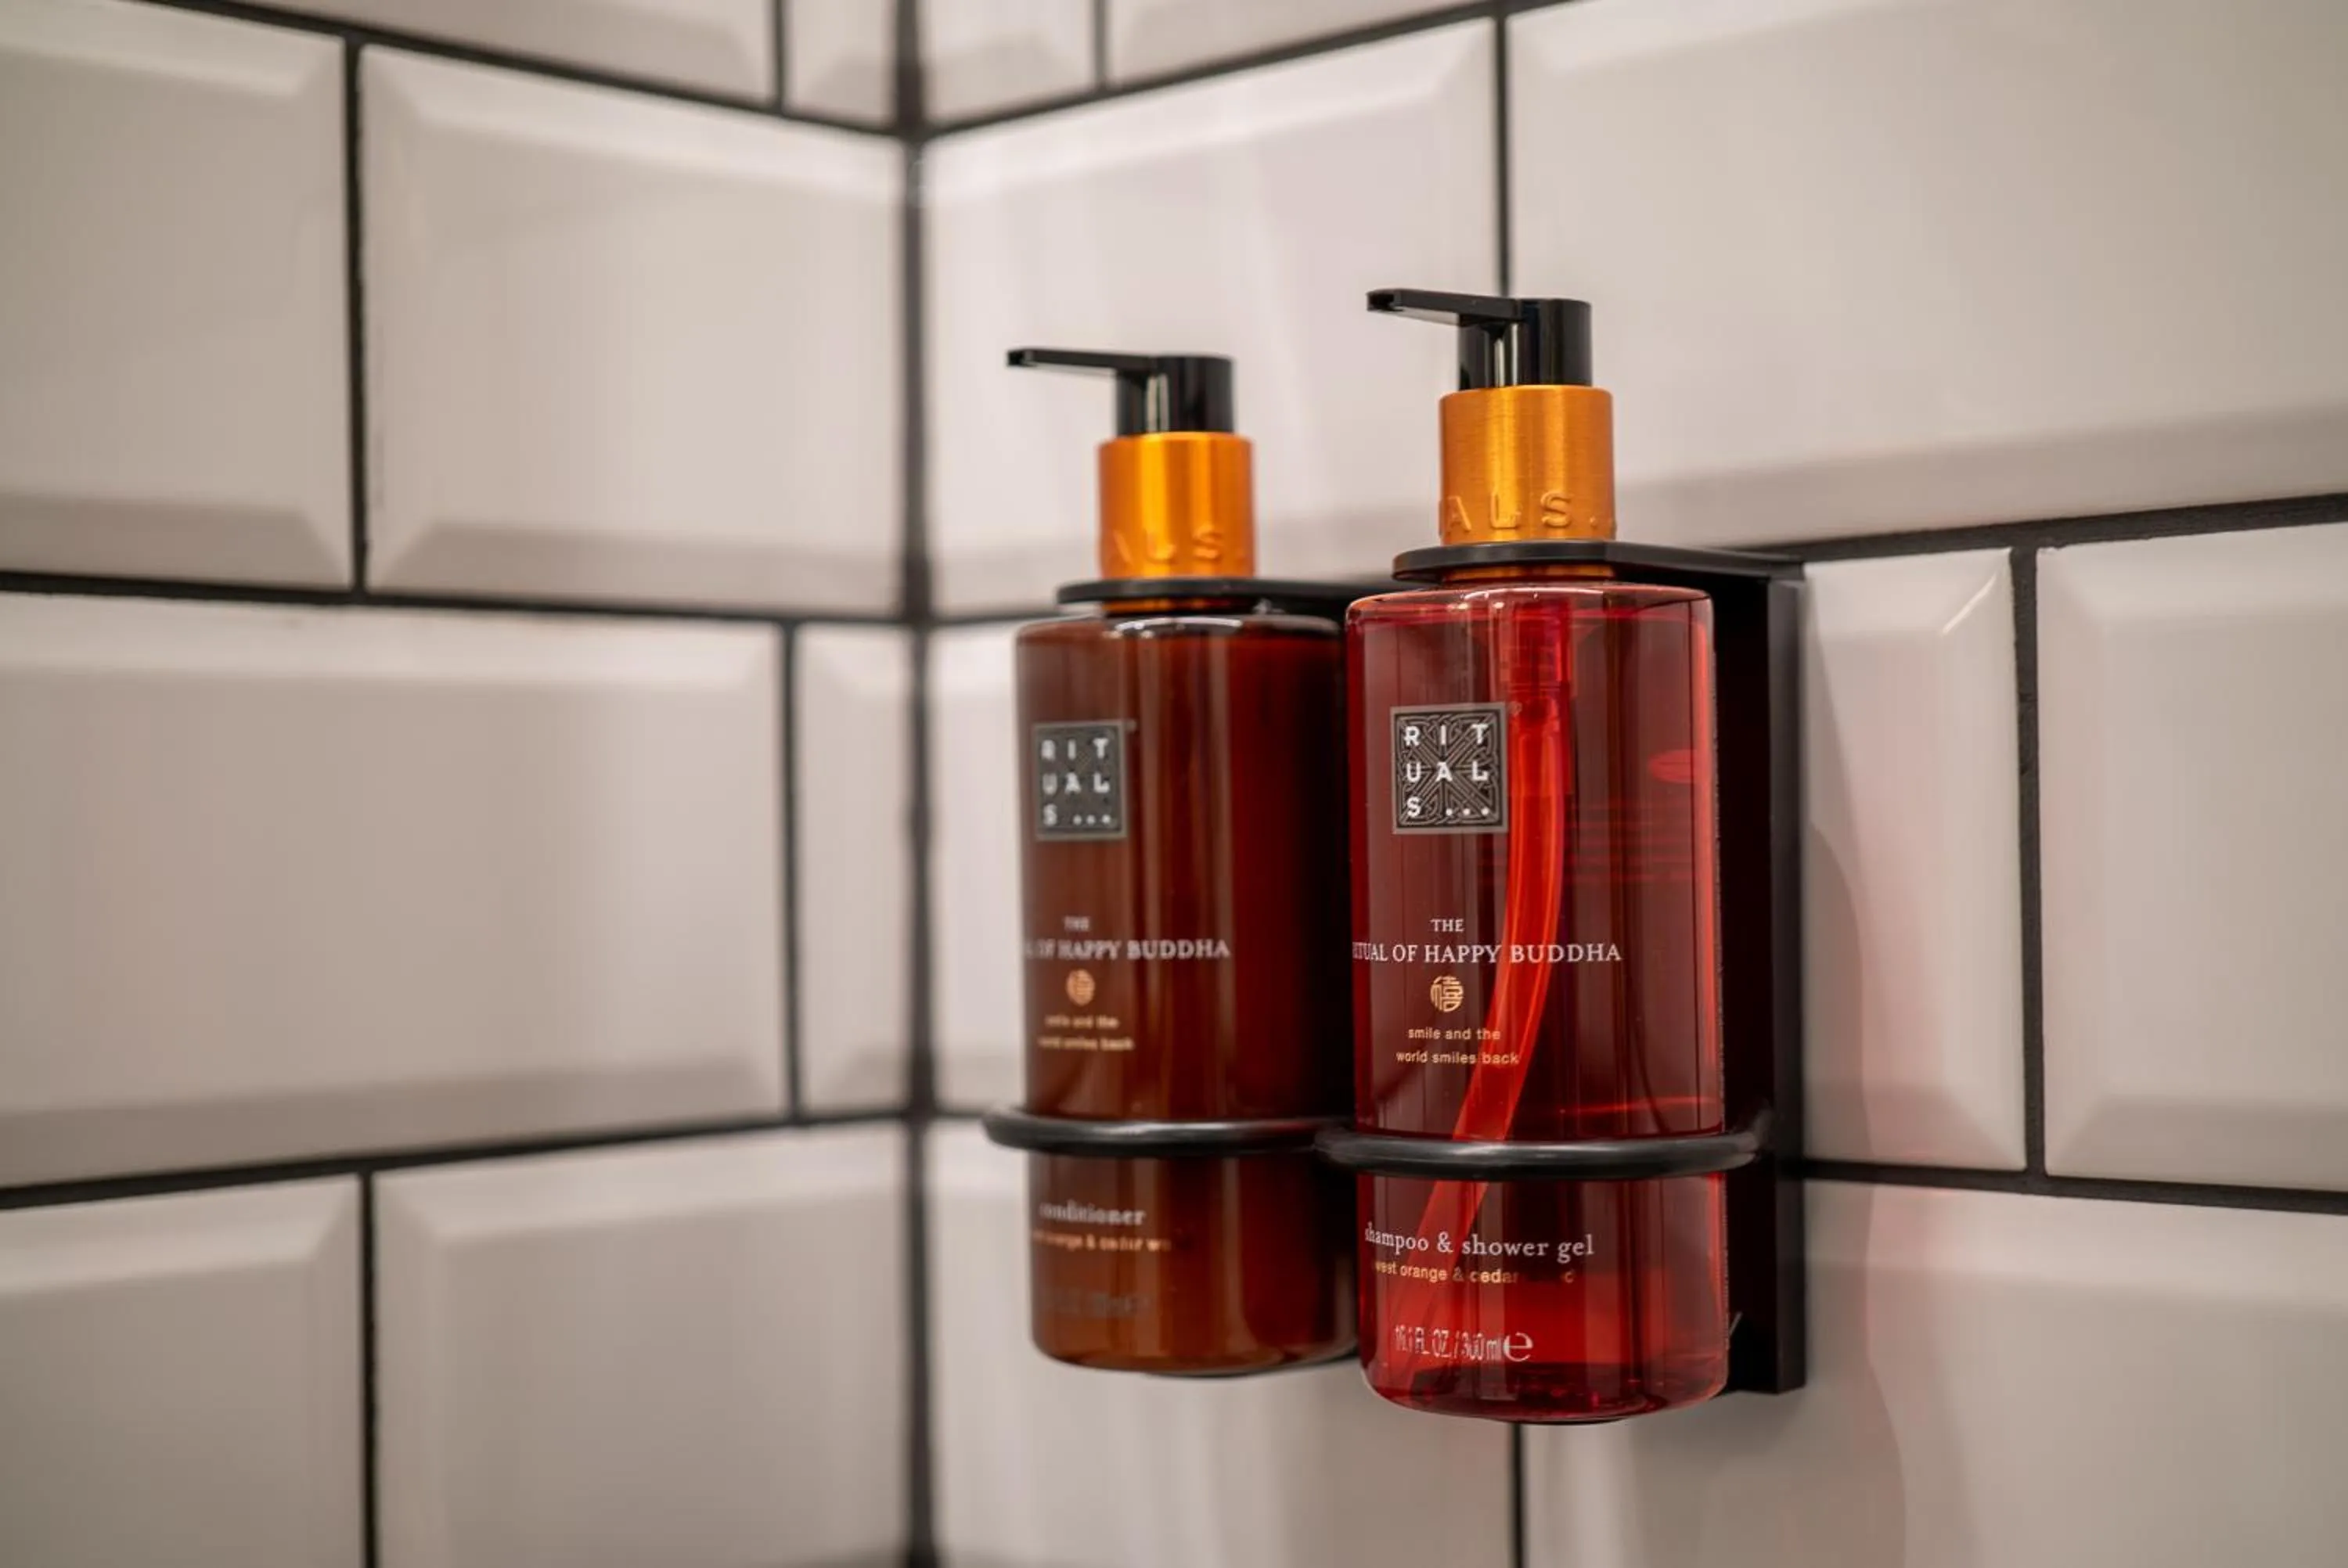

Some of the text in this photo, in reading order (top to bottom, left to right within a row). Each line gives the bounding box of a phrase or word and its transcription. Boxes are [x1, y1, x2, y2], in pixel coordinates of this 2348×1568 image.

[1430, 918, 1465, 933] THE
[1127, 939, 1231, 960] BUDDHA
[1392, 944, 1418, 963] OF
[1424, 944, 1502, 964] HAPPY
[1509, 943, 1623, 963] BUDDHA
[1407, 1026, 1501, 1041] smile and the
[1395, 1050, 1520, 1065] world smiles back
[1365, 1221, 1594, 1264] shampoo & shower gel
[1400, 1264, 1448, 1283] orange
